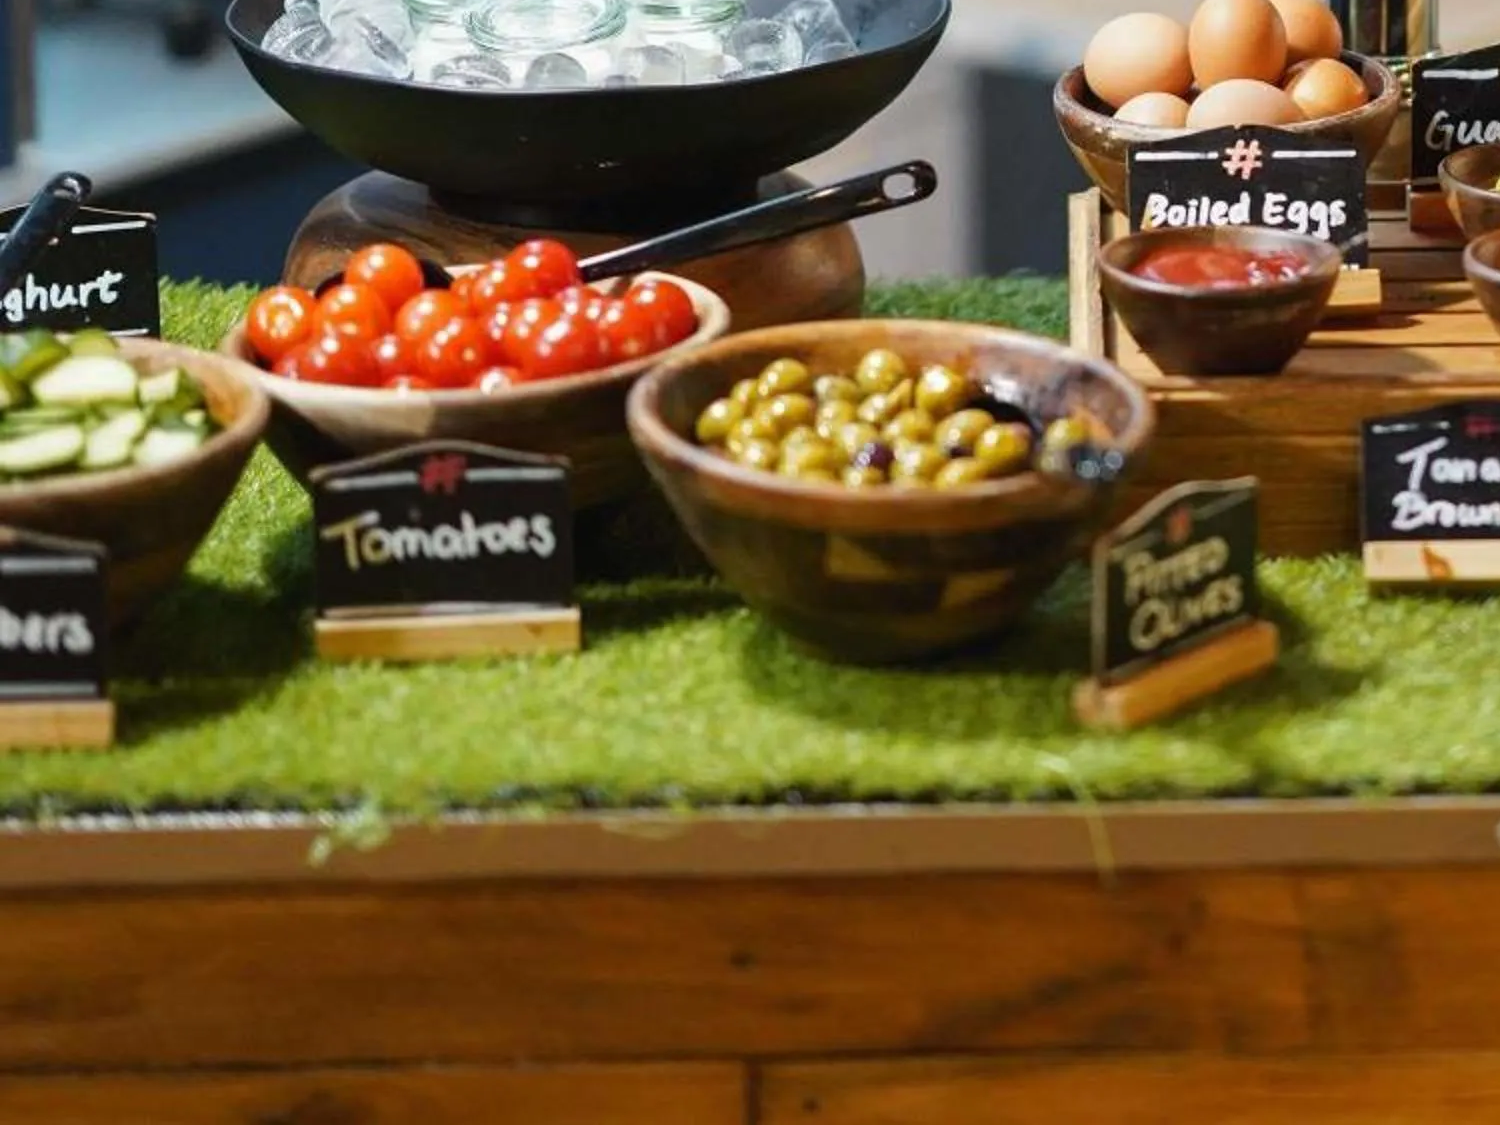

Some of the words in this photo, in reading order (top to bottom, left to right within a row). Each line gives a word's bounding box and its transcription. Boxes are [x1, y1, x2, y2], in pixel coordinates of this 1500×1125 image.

[1140, 190, 1251, 228] Boiled
[1261, 191, 1348, 241] Eggs
[0, 270, 124, 322] ghurt
[320, 509, 557, 572] Tomatoes
